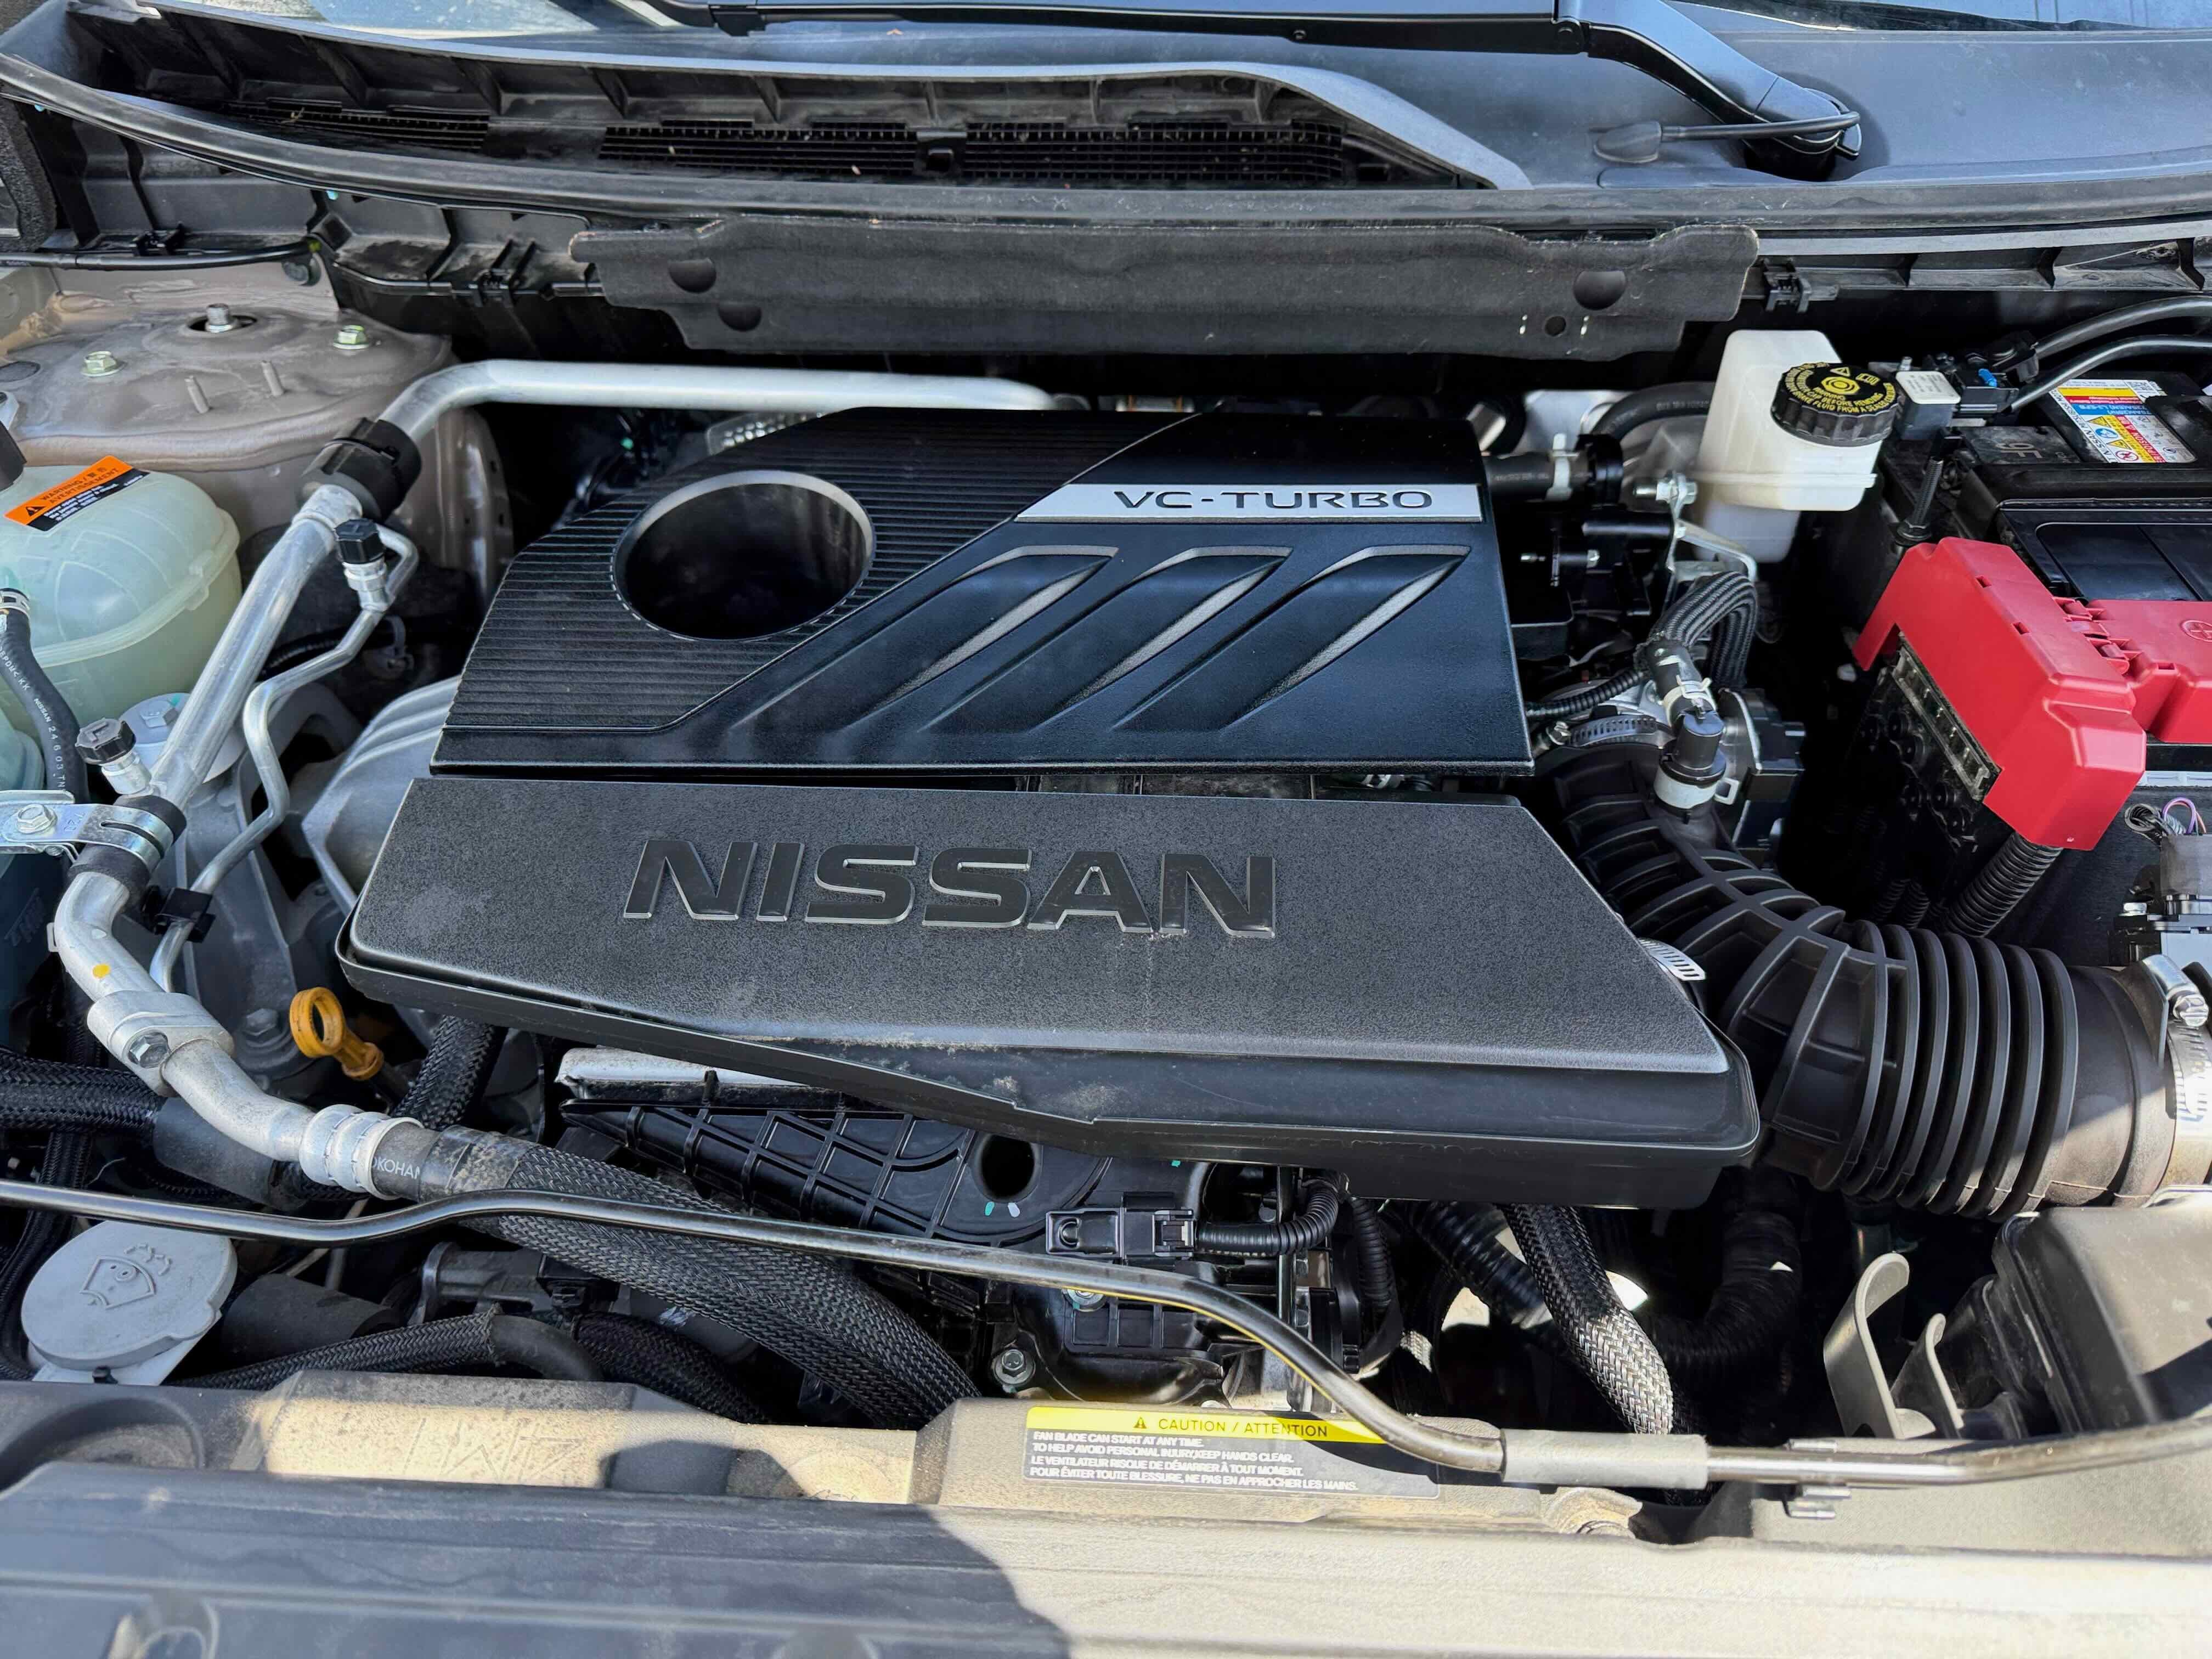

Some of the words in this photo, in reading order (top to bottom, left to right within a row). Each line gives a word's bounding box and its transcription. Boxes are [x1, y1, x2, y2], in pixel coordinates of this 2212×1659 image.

[1812, 400, 1835, 411] FLUID
[1114, 490, 1434, 510] VC-TURBO
[623, 839, 1277, 939] NISSAN
[1158, 1418, 1226, 1432] CAUTION
[1244, 1423, 1328, 1437] ATTENTION
[1034, 1431, 1054, 1441] FAN
[1054, 1431, 1087, 1442] BLADE
[1087, 1433, 1110, 1443] CAN
[1111, 1434, 1142, 1444] START
[1142, 1436, 1156, 1445] AT
[1156, 1436, 1177, 1446] ANY
[1032, 1442, 1047, 1452] TO
[1048, 1443, 1075, 1453] HELP
[1074, 1444, 1105, 1454] AVOID
[1106, 1445, 1160, 1457] PERSONAL
[1221, 1451, 1258, 1462] HANDS
[1031, 1455, 1045, 1465] LE
[1045, 1455, 1109, 1467] VENTILATEUR
[1109, 1458, 1148, 1470] RISQUE
[1148, 1460, 1164, 1470] DE
[1164, 1459, 1220, 1472] DÉMARRER
[1220, 1461, 1229, 1472] À
[1229, 1464, 1257, 1474] TOUT
[1029, 1466, 1060, 1477] POUR
[1060, 1465, 1095, 1478] ÉVITER
[1095, 1470, 1129, 1480] TOUTE
[1185, 1474, 1201, 1483] NE
[1201, 1474, 1222, 1485] PAS
[1222, 1475, 1238, 1485] EN
[1238, 1476, 1302, 1488] APPROCHER
[1302, 1479, 1323, 1489] LES
